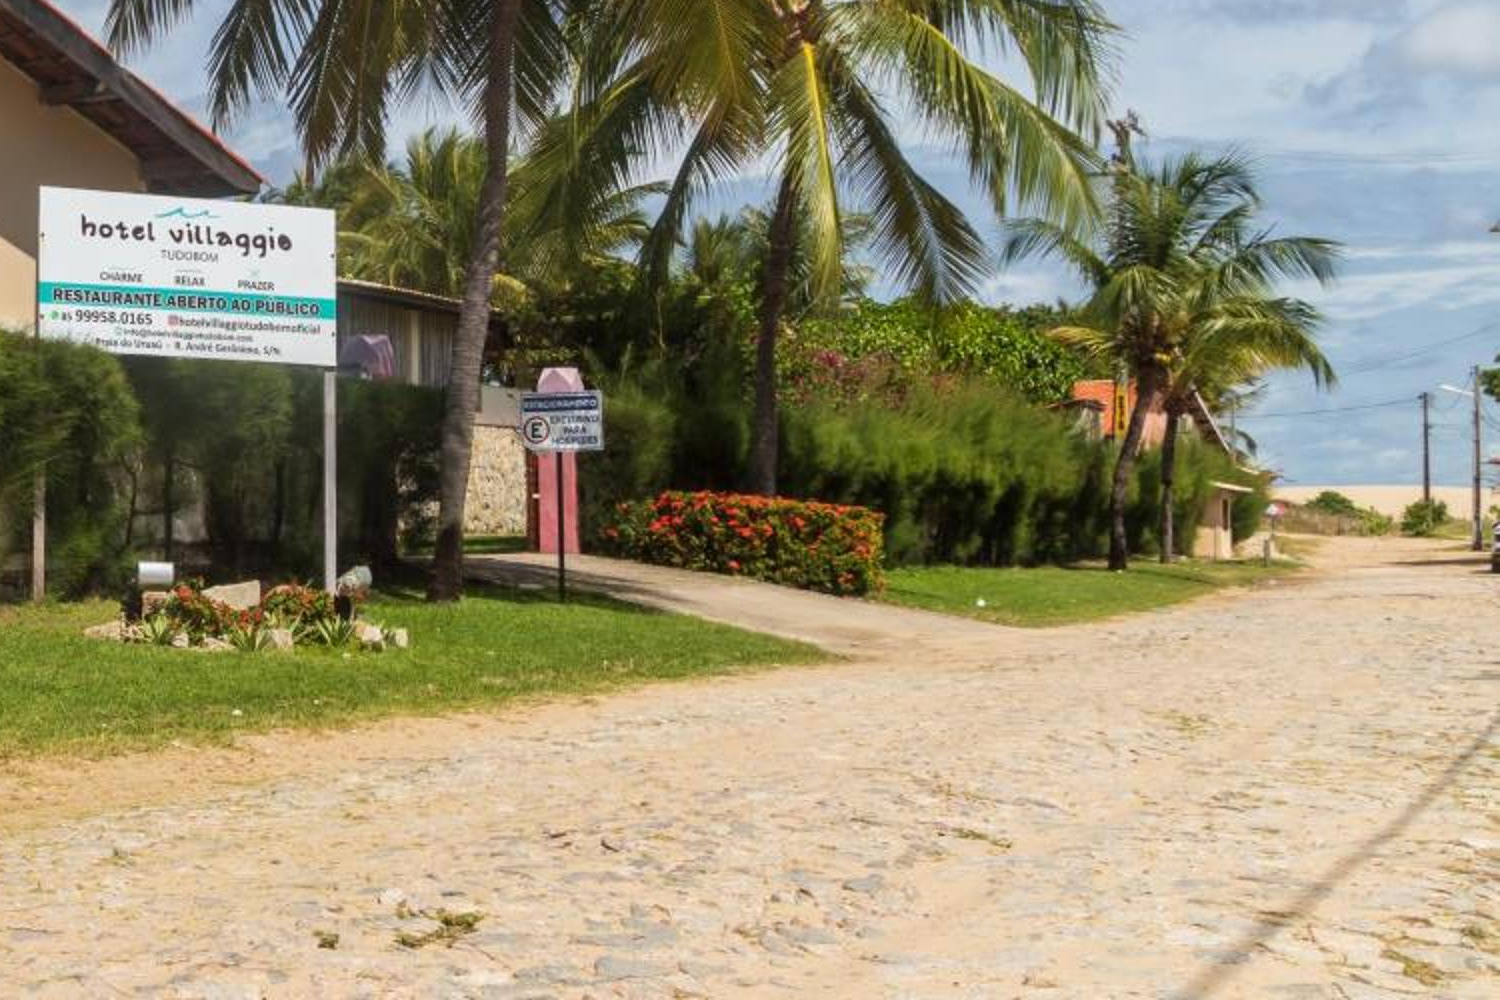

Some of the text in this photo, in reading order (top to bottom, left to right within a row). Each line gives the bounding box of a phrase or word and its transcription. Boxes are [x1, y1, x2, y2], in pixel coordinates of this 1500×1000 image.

[80, 214, 293, 258] hotel villaggio
[100, 271, 275, 291] CHARME RELAX PRAZER
[53, 288, 161, 307] RESTAURANTE
[167, 296, 227, 311] ABERTO
[231, 300, 250, 312] AO
[75, 309, 153, 325] 99958.0165
[531, 422, 542, 439] E
